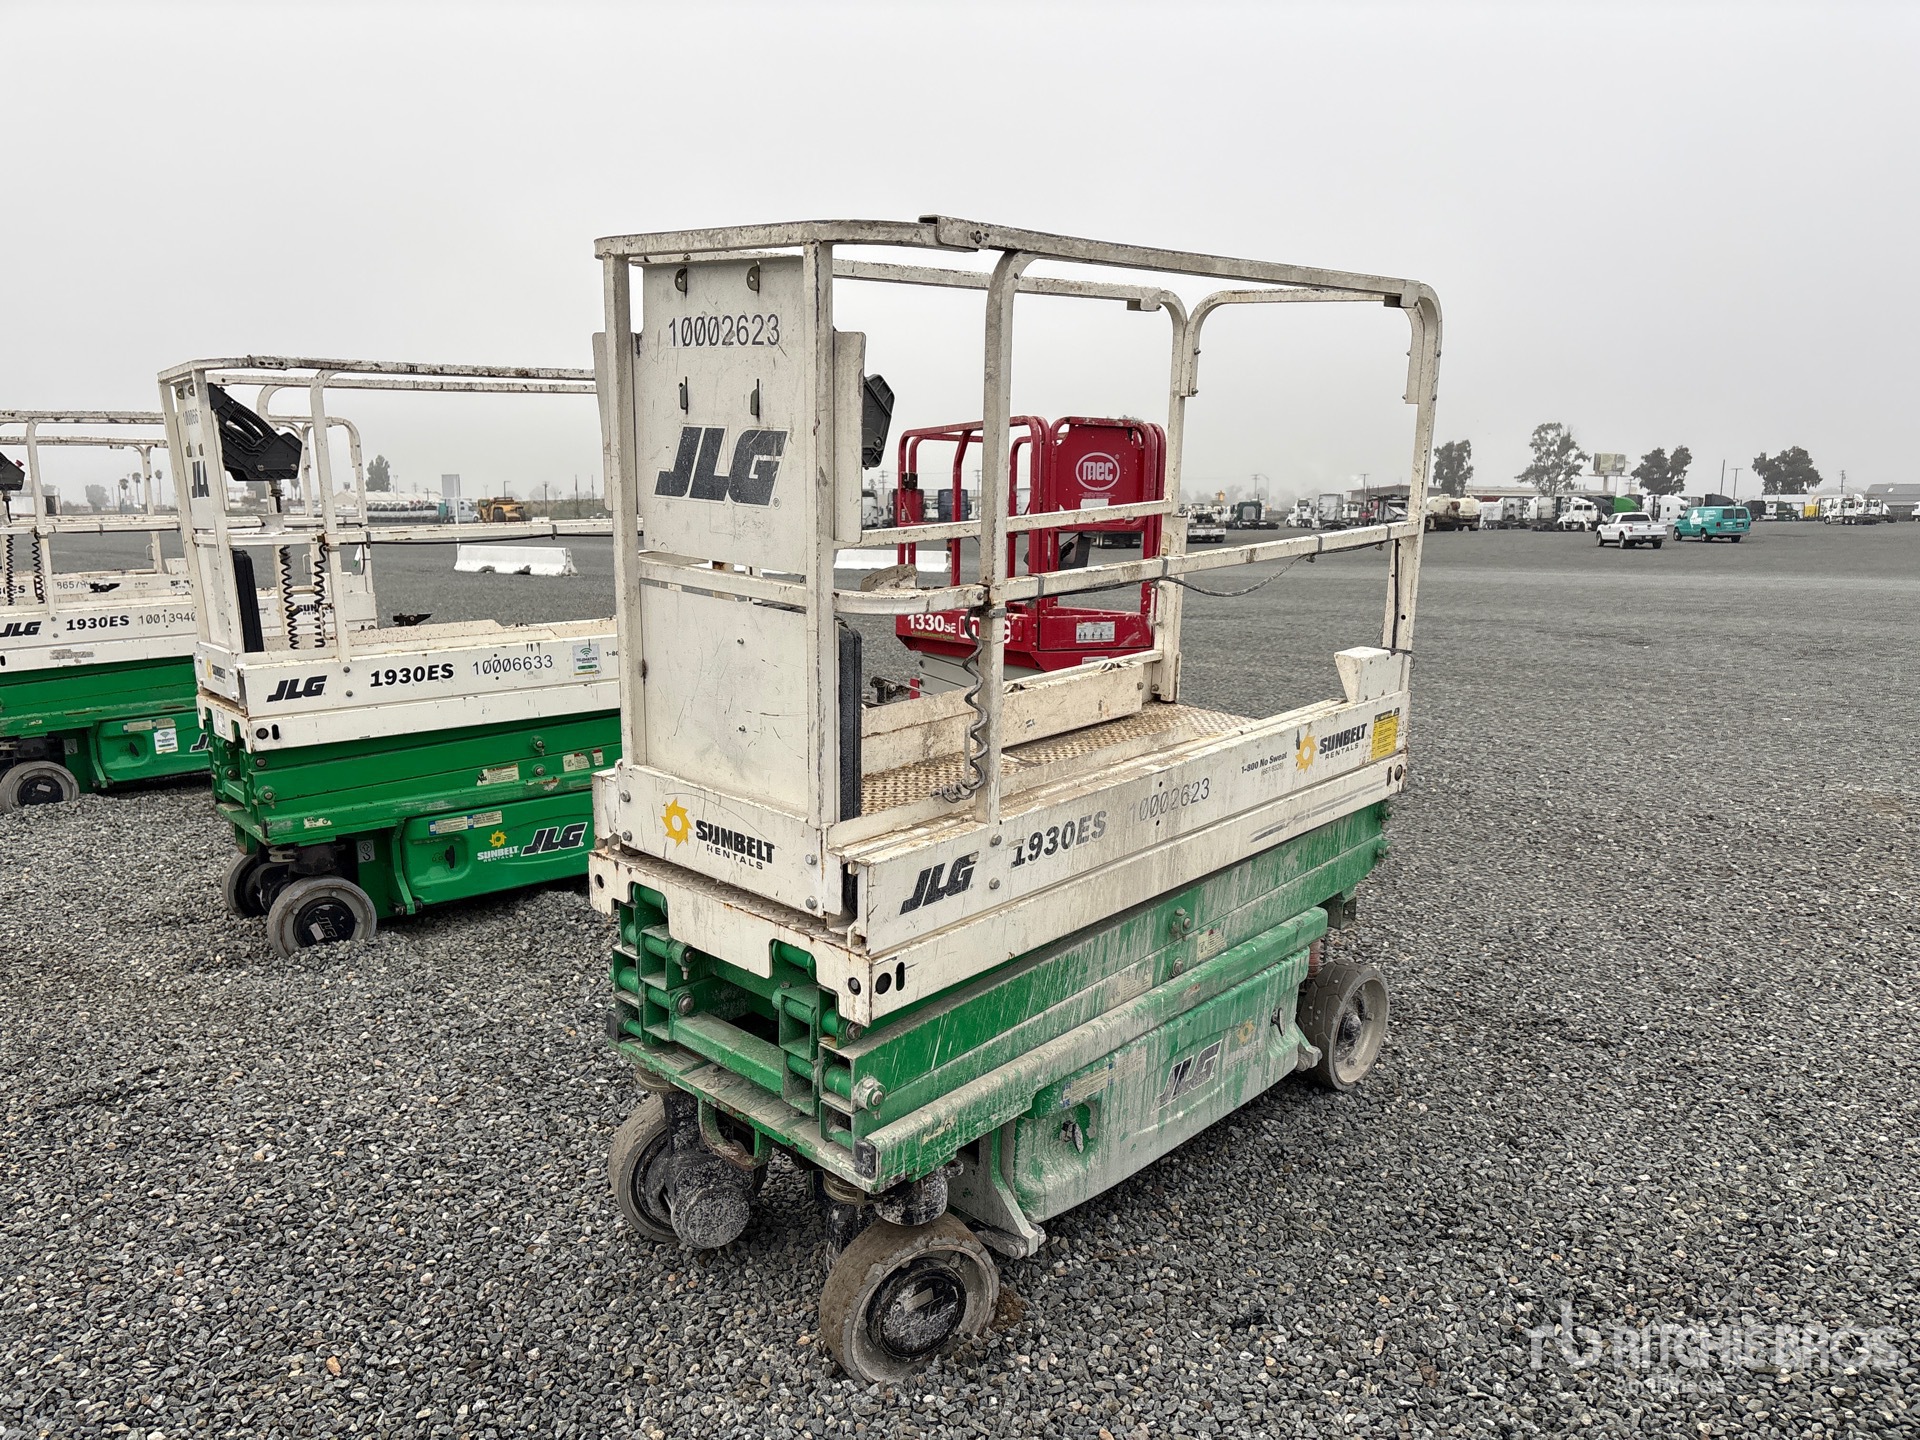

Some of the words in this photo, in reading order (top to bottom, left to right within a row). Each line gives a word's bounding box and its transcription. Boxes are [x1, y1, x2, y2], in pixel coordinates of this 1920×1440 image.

[669, 313, 780, 347] 10002623
[654, 426, 788, 507] JLG
[66, 615, 130, 631] 1930ES
[907, 614, 945, 632] 1330
[266, 675, 328, 702] JLG
[370, 663, 455, 687] 1930ES
[472, 654, 554, 676] 10006633
[1319, 723, 1368, 755] SUNBELT
[1325, 743, 1359, 760] RENTALS
[1259, 758, 1269, 768] No
[1269, 751, 1288, 764] Sweat
[477, 845, 519, 861] SUNBELT
[520, 822, 588, 857] JLG
[695, 819, 776, 864] SUNBELT
[706, 844, 764, 870] RENTALS
[899, 851, 980, 916] JLG
[1010, 810, 1108, 869] 1930ES
[1129, 777, 1211, 825] 10002623
[1151, 1039, 1224, 1114] JLG
